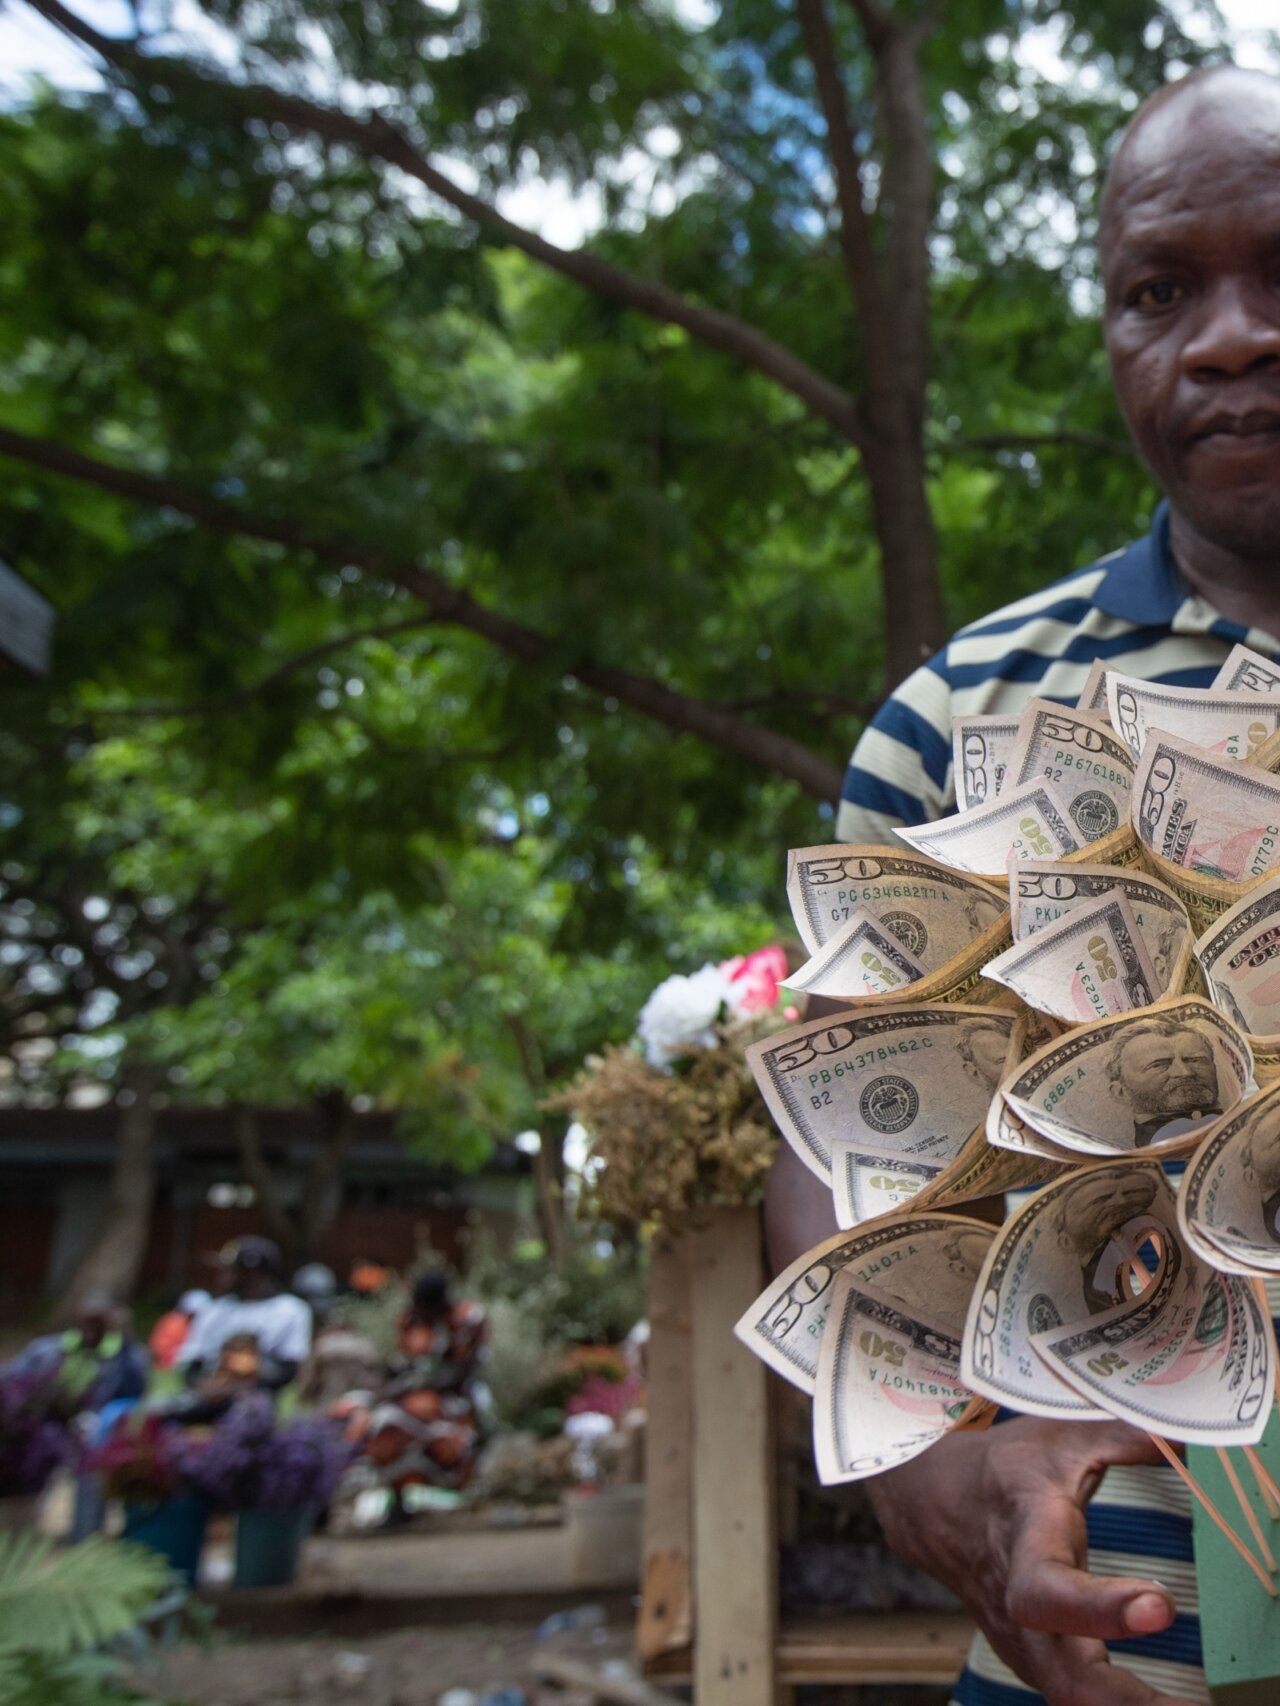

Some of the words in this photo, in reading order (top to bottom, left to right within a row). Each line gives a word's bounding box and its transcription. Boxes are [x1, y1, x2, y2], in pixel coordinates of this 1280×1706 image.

[1040, 712, 1104, 753] 50
[963, 733, 988, 798] 50
[1043, 766, 1064, 783] B2
[1141, 756, 1176, 826] 50
[1266, 824, 1279, 836] C
[808, 857, 884, 885] 50
[863, 887, 938, 901] 63468277
[942, 892, 950, 901] A
[1019, 876, 1078, 900] 50
[831, 907, 850, 922] G7
[1135, 913, 1144, 926] A
[1076, 961, 1086, 972] A
[1088, 936, 1118, 982] 50
[1248, 943, 1280, 968] OF
[775, 1026, 856, 1073] 50
[866, 1014, 946, 1030] FEDERAL
[808, 1069, 832, 1089] PB
[833, 1039, 921, 1078] 64378462
[921, 1037, 933, 1048] C
[809, 1090, 833, 1110] B2
[1043, 1074, 1075, 1113] 6885
[1076, 1067, 1087, 1080] A
[858, 1252, 902, 1283] 1407
[908, 1245, 919, 1255] A
[773, 1264, 834, 1338] 50
[972, 1288, 1000, 1378] 50
[859, 1330, 907, 1368] 50
[869, 1368, 877, 1381] A
[1086, 1350, 1130, 1378] 50
